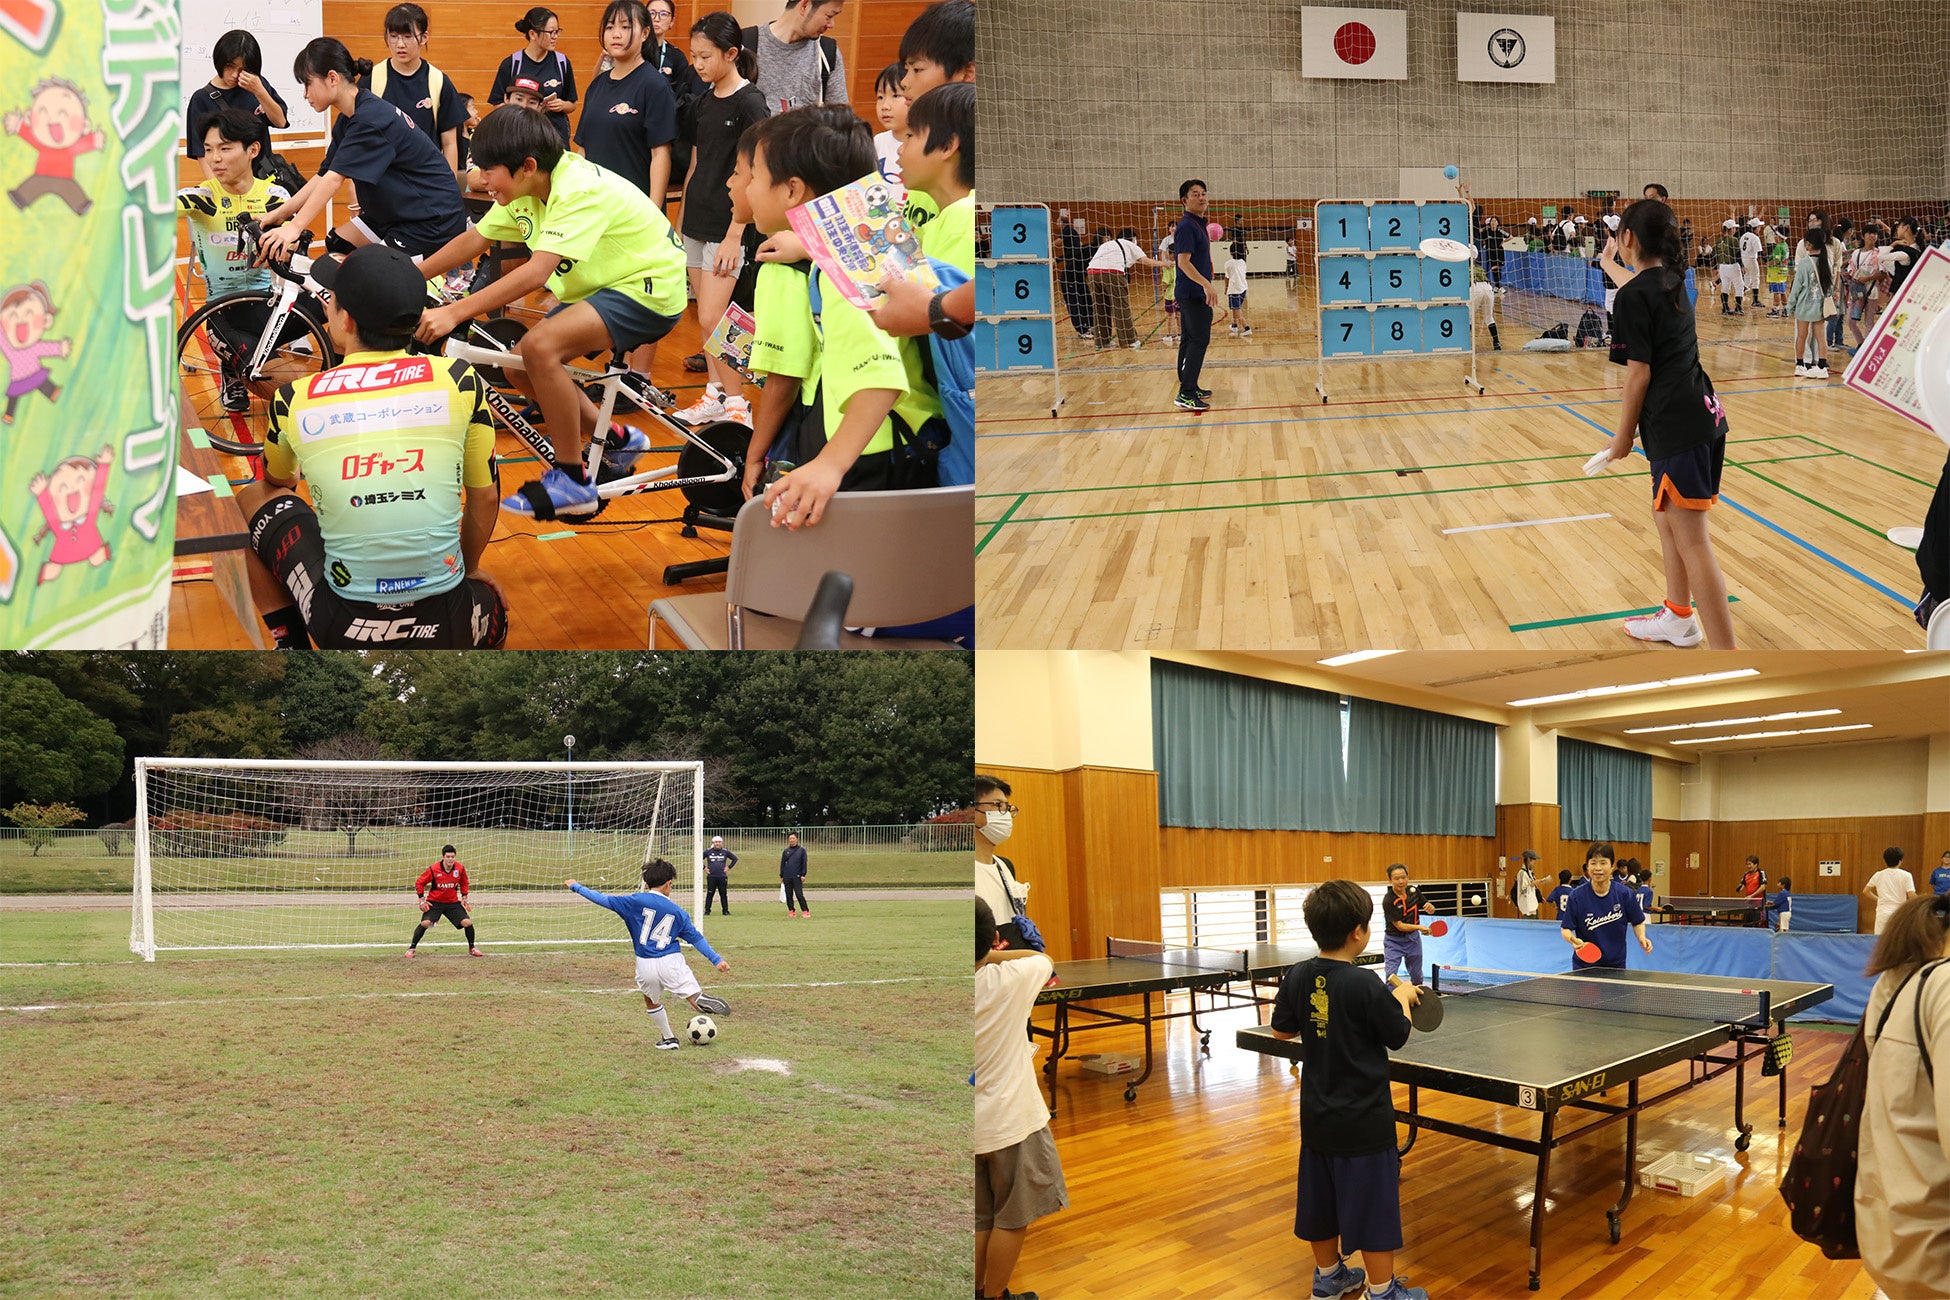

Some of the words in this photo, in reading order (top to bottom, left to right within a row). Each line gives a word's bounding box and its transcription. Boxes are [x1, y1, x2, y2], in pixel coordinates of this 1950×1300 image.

[1013, 223, 1027, 244] 3
[1338, 218, 1347, 238] 1
[1388, 218, 1401, 237] 2
[1438, 217, 1451, 236] 3
[104, 0, 179, 542] ディレーブ
[1339, 271, 1351, 290] 4
[1389, 269, 1402, 288] 5
[1439, 268, 1452, 287] 6
[1015, 279, 1030, 299] 6
[1340, 323, 1353, 342] 7
[1391, 321, 1404, 341] 8
[1440, 319, 1453, 338] 9
[1017, 334, 1033, 355] 9
[1868, 345, 1887, 373] グルメ
[394, 364, 426, 383] TIRE
[329, 403, 443, 426] 武蔵コーポレーション
[485, 386, 556, 465] KhodaaBloo
[341, 448, 425, 480] ロヂャース
[653, 477, 706, 489] KhodaaBloom
[364, 488, 427, 505] 埼玉シミズ
[409, 623, 440, 639] TIRE
[1826, 866, 1834, 874] 5
[639, 907, 676, 950] 14
[1585, 910, 1623, 928] Koinobori
[1040, 989, 1083, 1001] SAN-EI
[1561, 1072, 1607, 1101] SAN-EI
